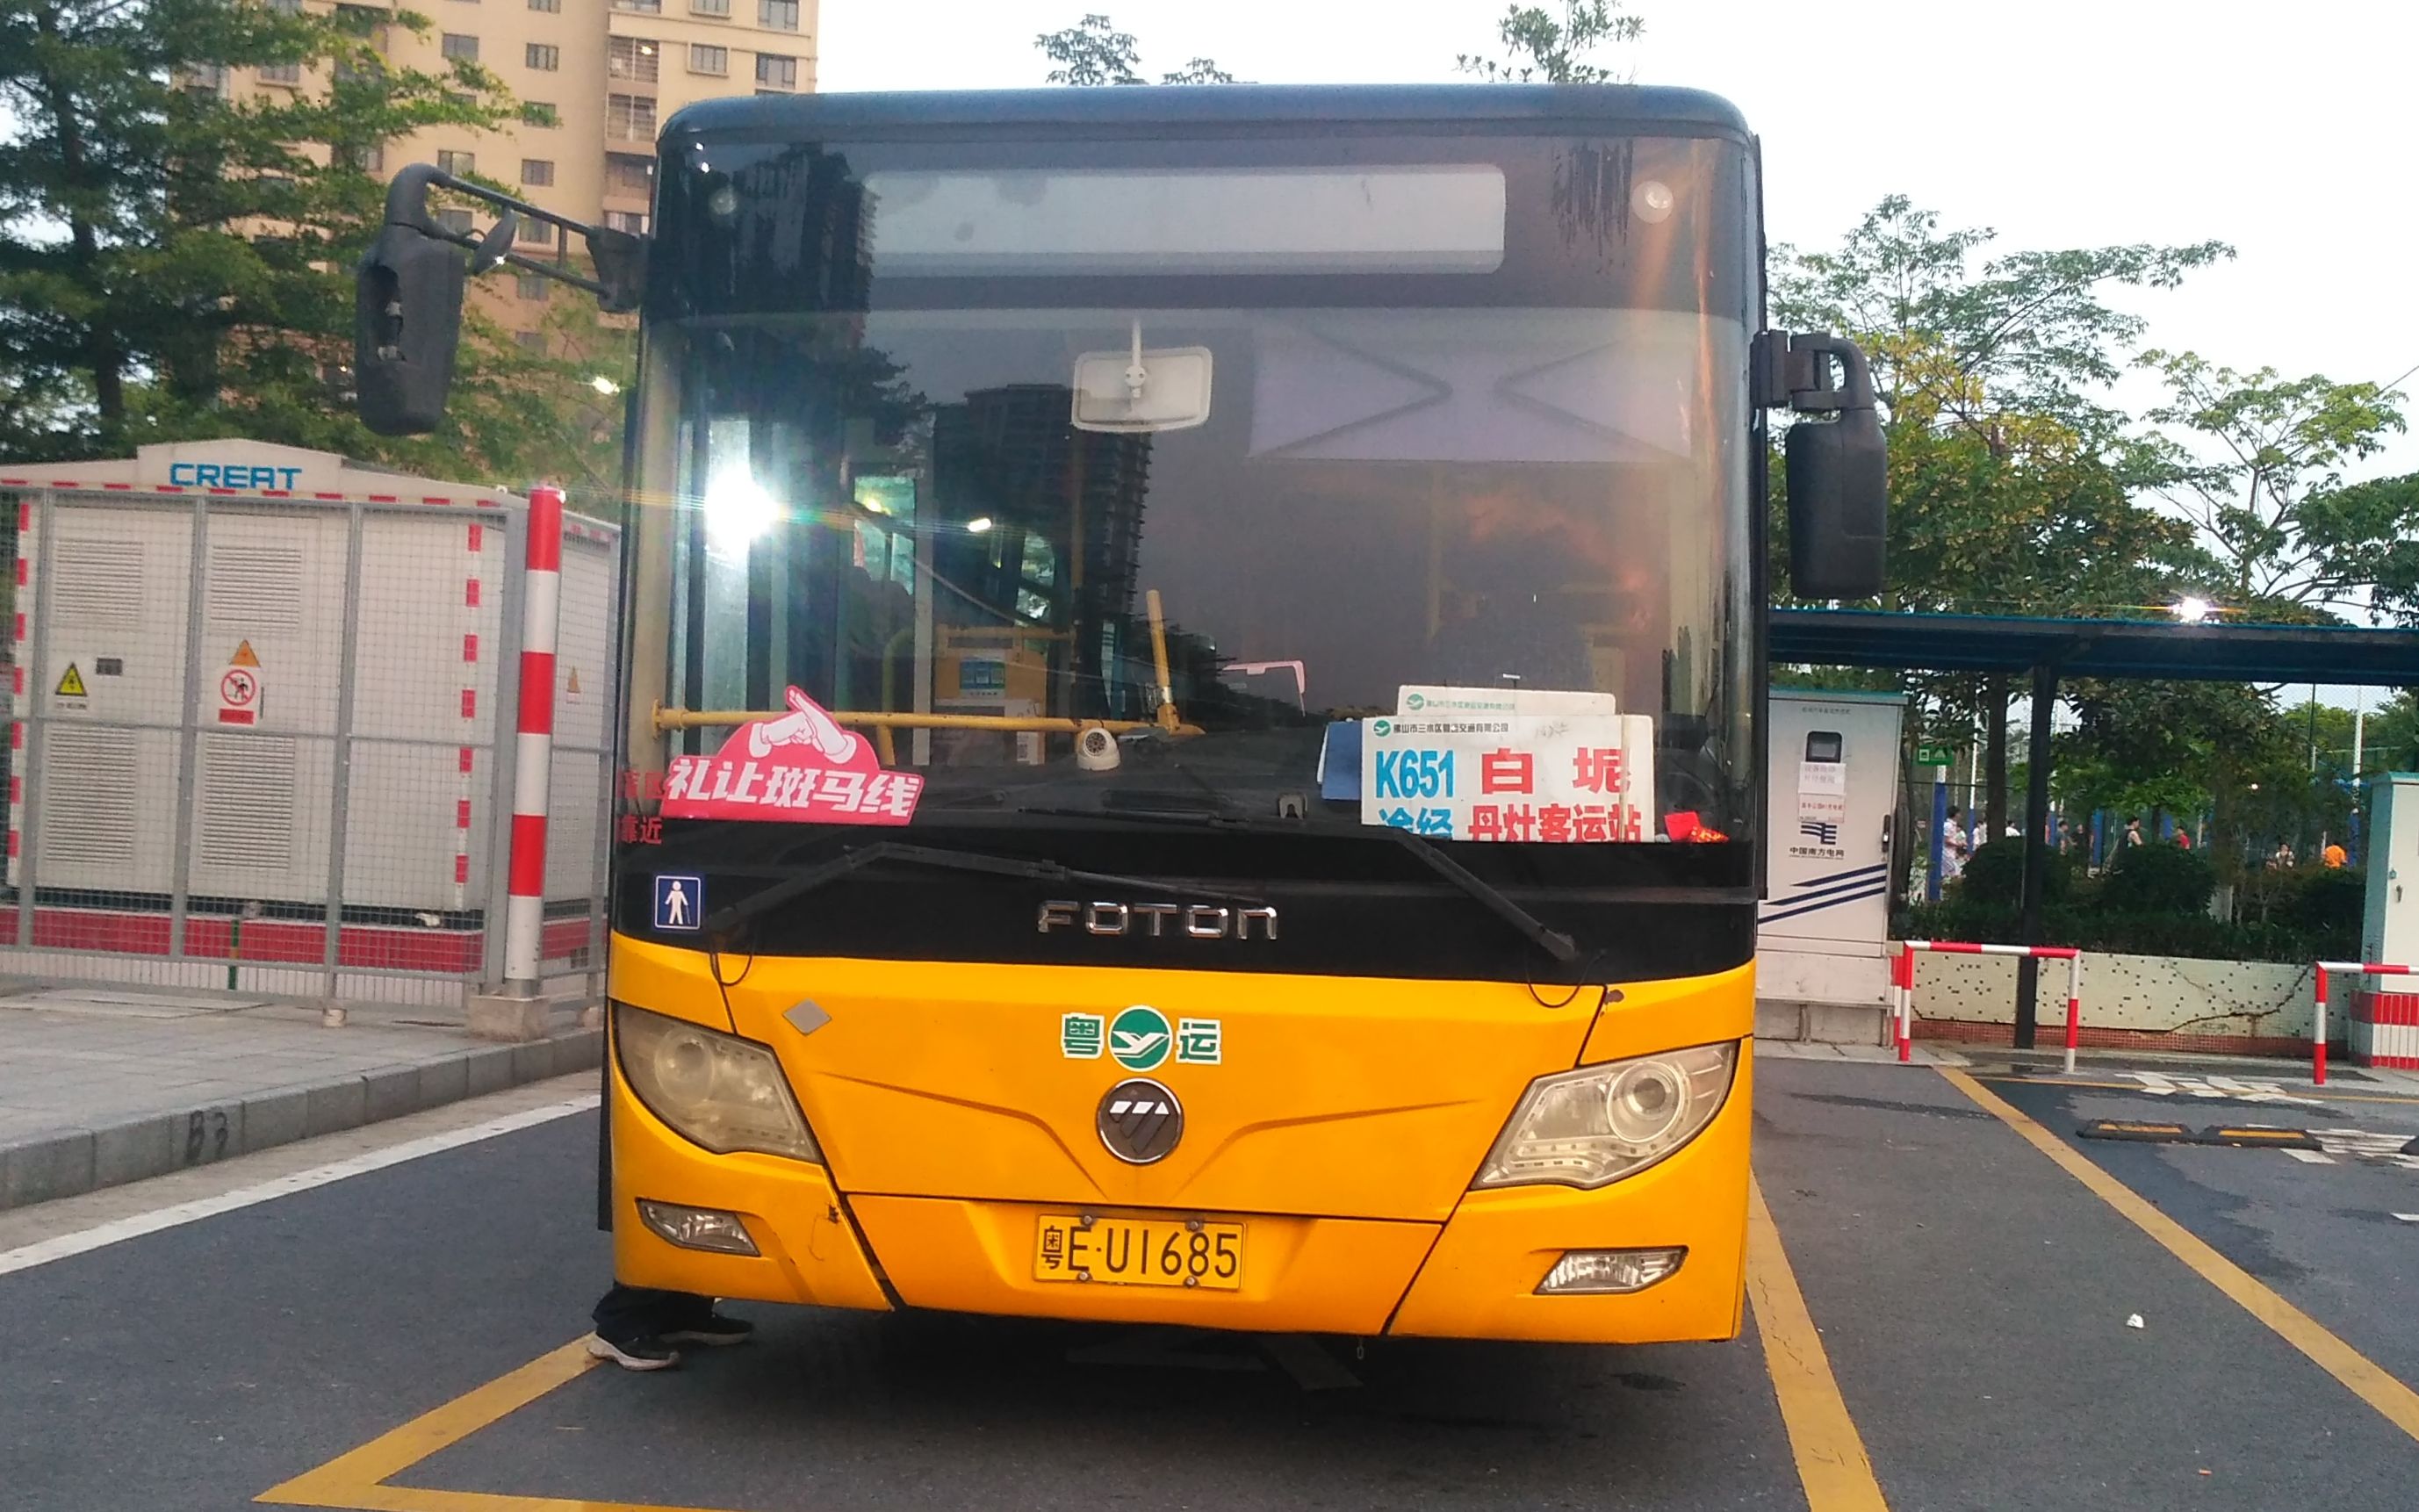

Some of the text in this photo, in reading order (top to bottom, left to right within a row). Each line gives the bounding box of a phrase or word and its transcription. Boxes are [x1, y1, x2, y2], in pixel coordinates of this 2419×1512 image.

[169, 463, 302, 491] CREAT
[667, 759, 920, 817] 礼让斑马线
[1375, 749, 1454, 799] K651
[1467, 803, 1643, 843] 丹灶客运站
[1789, 846, 1845, 857] 中国南方电网
[1037, 900, 1279, 940] FOTON
